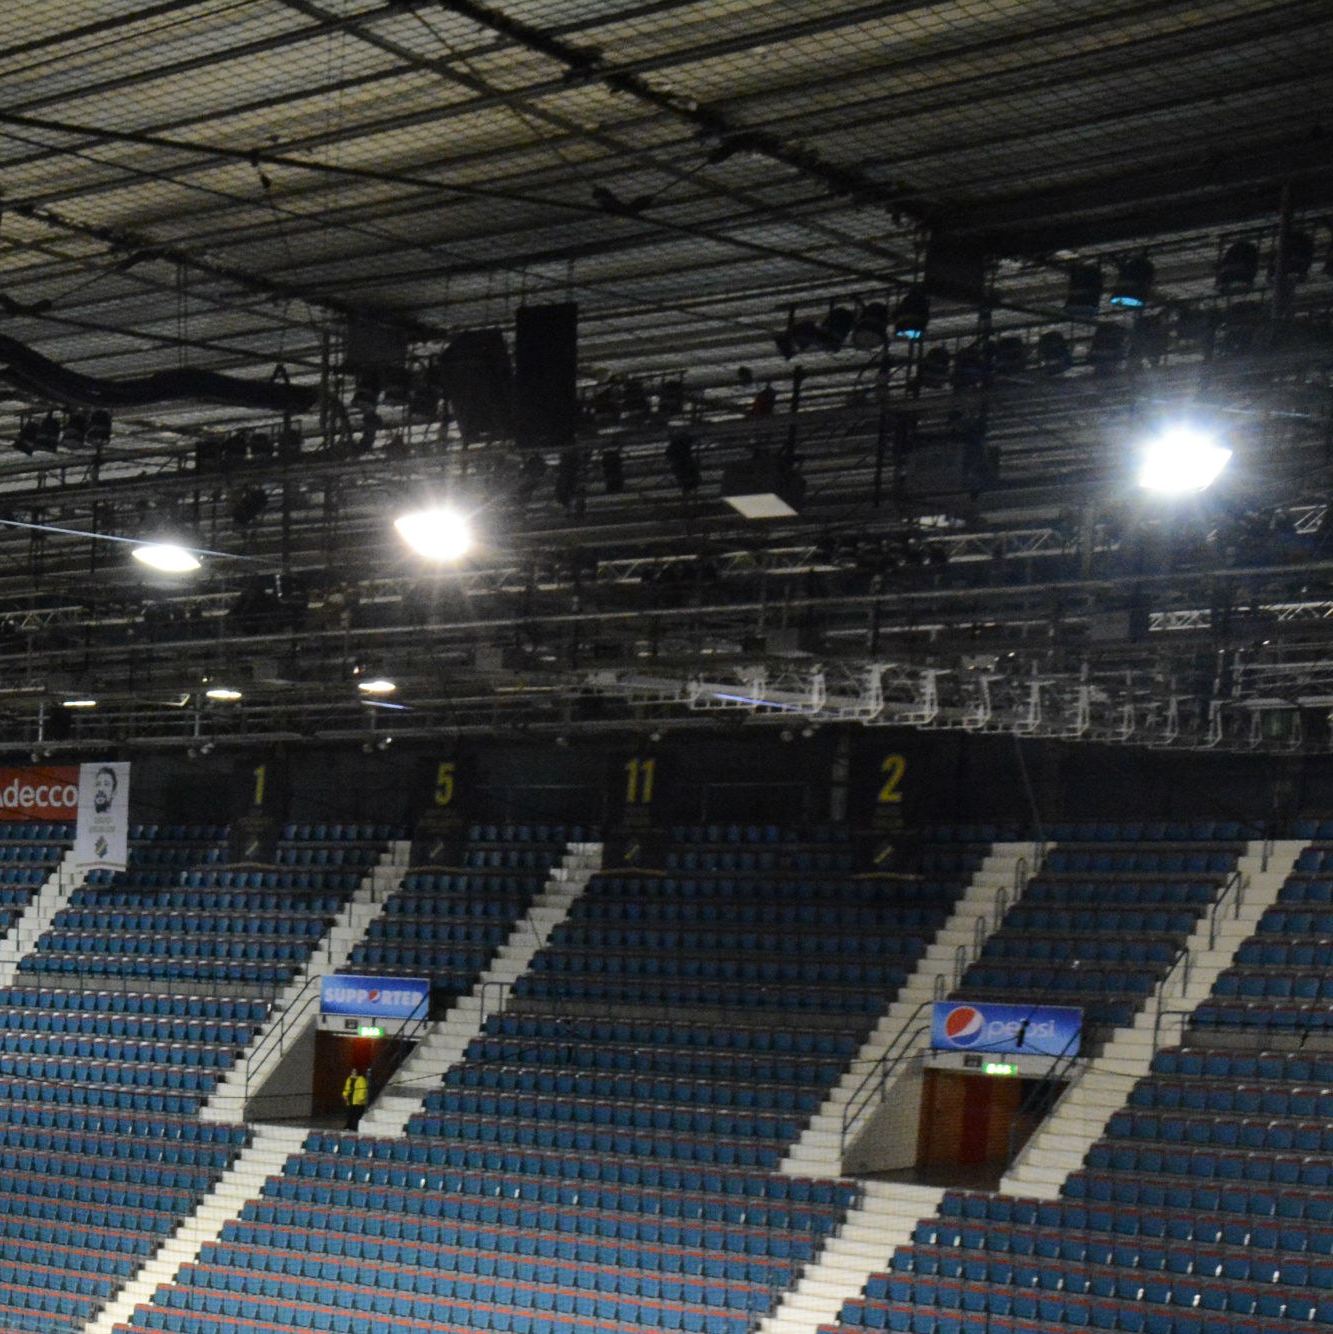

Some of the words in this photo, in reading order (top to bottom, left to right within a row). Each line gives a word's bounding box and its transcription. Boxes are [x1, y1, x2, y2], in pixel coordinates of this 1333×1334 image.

[254, 765, 266, 805] 1
[434, 762, 454, 806] 5
[625, 757, 656, 805] 11
[877, 754, 907, 803] 2
